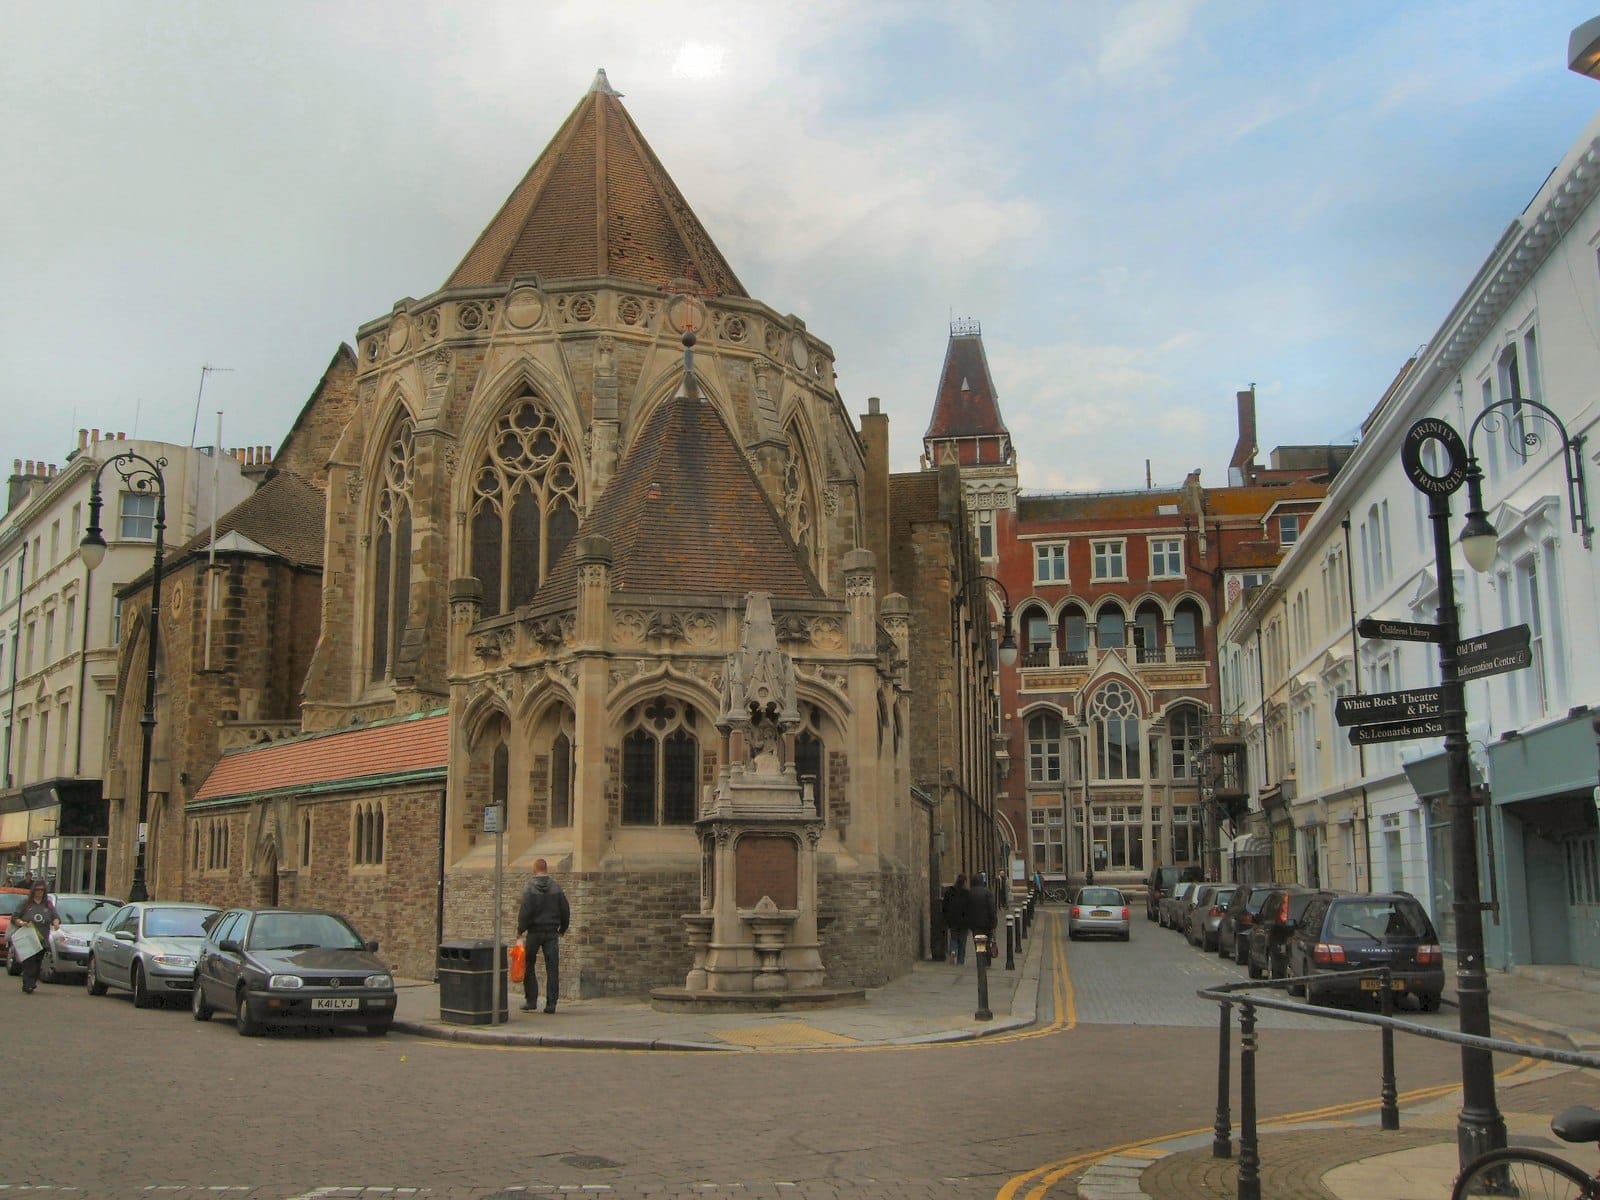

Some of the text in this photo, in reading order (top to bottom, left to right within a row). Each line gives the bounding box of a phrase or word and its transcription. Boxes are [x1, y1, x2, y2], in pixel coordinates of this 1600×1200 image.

[1410, 422, 1456, 442] TRINITY
[1412, 466, 1463, 492] TRIANGLE
[1409, 625, 1430, 639] Library
[1456, 641, 1488, 656] Old Town
[1457, 660, 1493, 677] Information
[1494, 656, 1516, 668] Centre
[1342, 692, 1439, 711] White Rock Theatre
[1407, 703, 1439, 715] & Pier
[1371, 725, 1410, 738] Leonards
[1412, 725, 1424, 734] on
[1425, 722, 1442, 732] Sea
